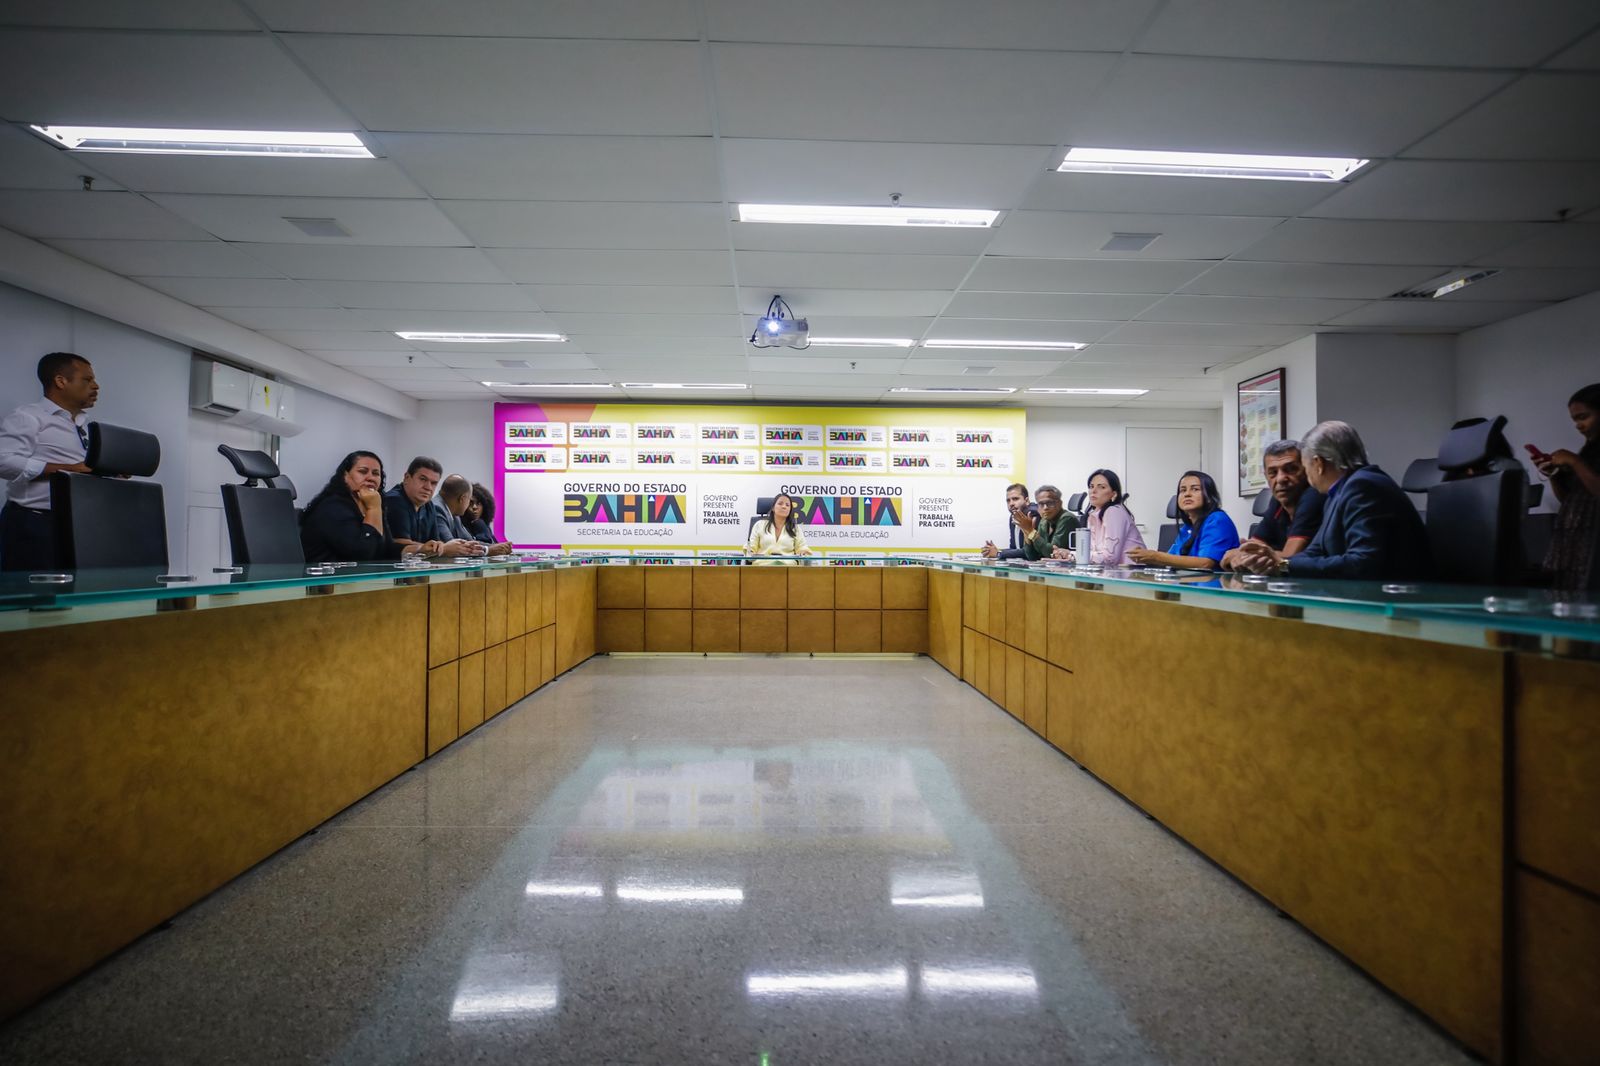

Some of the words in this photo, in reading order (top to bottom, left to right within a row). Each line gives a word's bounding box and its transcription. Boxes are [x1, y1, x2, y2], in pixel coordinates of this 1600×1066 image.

[509, 428, 547, 438] BAHIA
[573, 429, 611, 438] BAHIA
[637, 429, 675, 439] BAHIA
[701, 430, 739, 439] BAHIA
[765, 431, 803, 440] BAHIA
[829, 432, 867, 441] BAHIA
[893, 433, 930, 442] BAHIA
[956, 434, 993, 443] BAHIA
[509, 454, 547, 463] BAHIA
[573, 454, 611, 463] BAHIA
[637, 454, 675, 464] BAHIA
[701, 455, 739, 465] BAHIA
[765, 456, 803, 465] BAHIA
[829, 457, 867, 466] BAHIA
[893, 458, 930, 467] BAHIA
[956, 459, 993, 468] BAHIA
[564, 483, 620, 492] GOVERNO
[624, 483, 640, 492] DO
[644, 484, 686, 493] ESTADO
[781, 485, 836, 495] GOVERNO
[840, 486, 856, 495] DO
[860, 486, 902, 495] ESTADO
[564, 494, 686, 523] BAHIA
[577, 528, 620, 536] SECRETARIA
[622, 528, 632, 536] DA
[634, 528, 673, 536] EDUCAÇÃO
[804, 530, 837, 538] CRETARIA
[851, 530, 888, 539] EDUCAÇÃO
